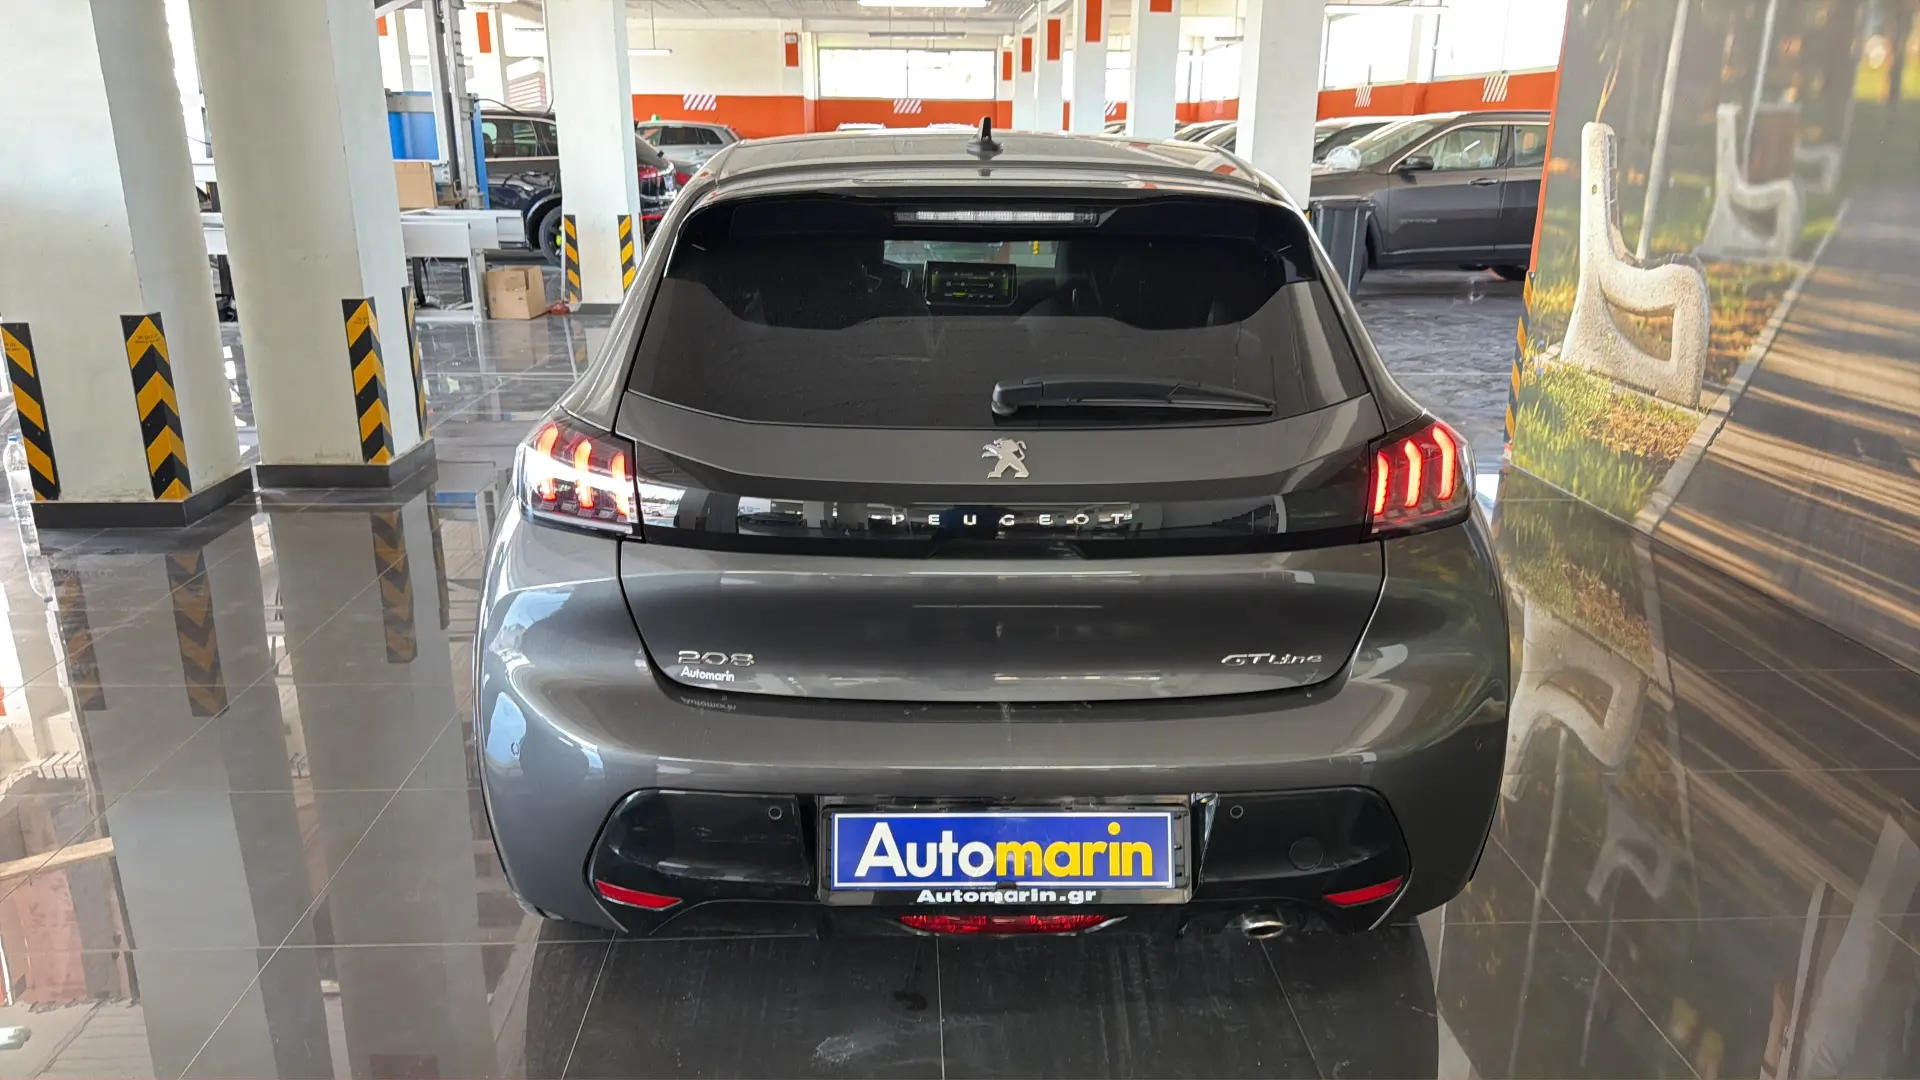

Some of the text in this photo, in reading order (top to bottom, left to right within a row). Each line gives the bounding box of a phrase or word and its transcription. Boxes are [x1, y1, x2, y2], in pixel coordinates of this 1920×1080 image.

[891, 513, 1123, 526] PEUGEOT
[678, 650, 755, 667] 208
[680, 665, 735, 682] Automarin
[854, 821, 1153, 878] Automarin
[916, 888, 1097, 905] Automarin.gr
